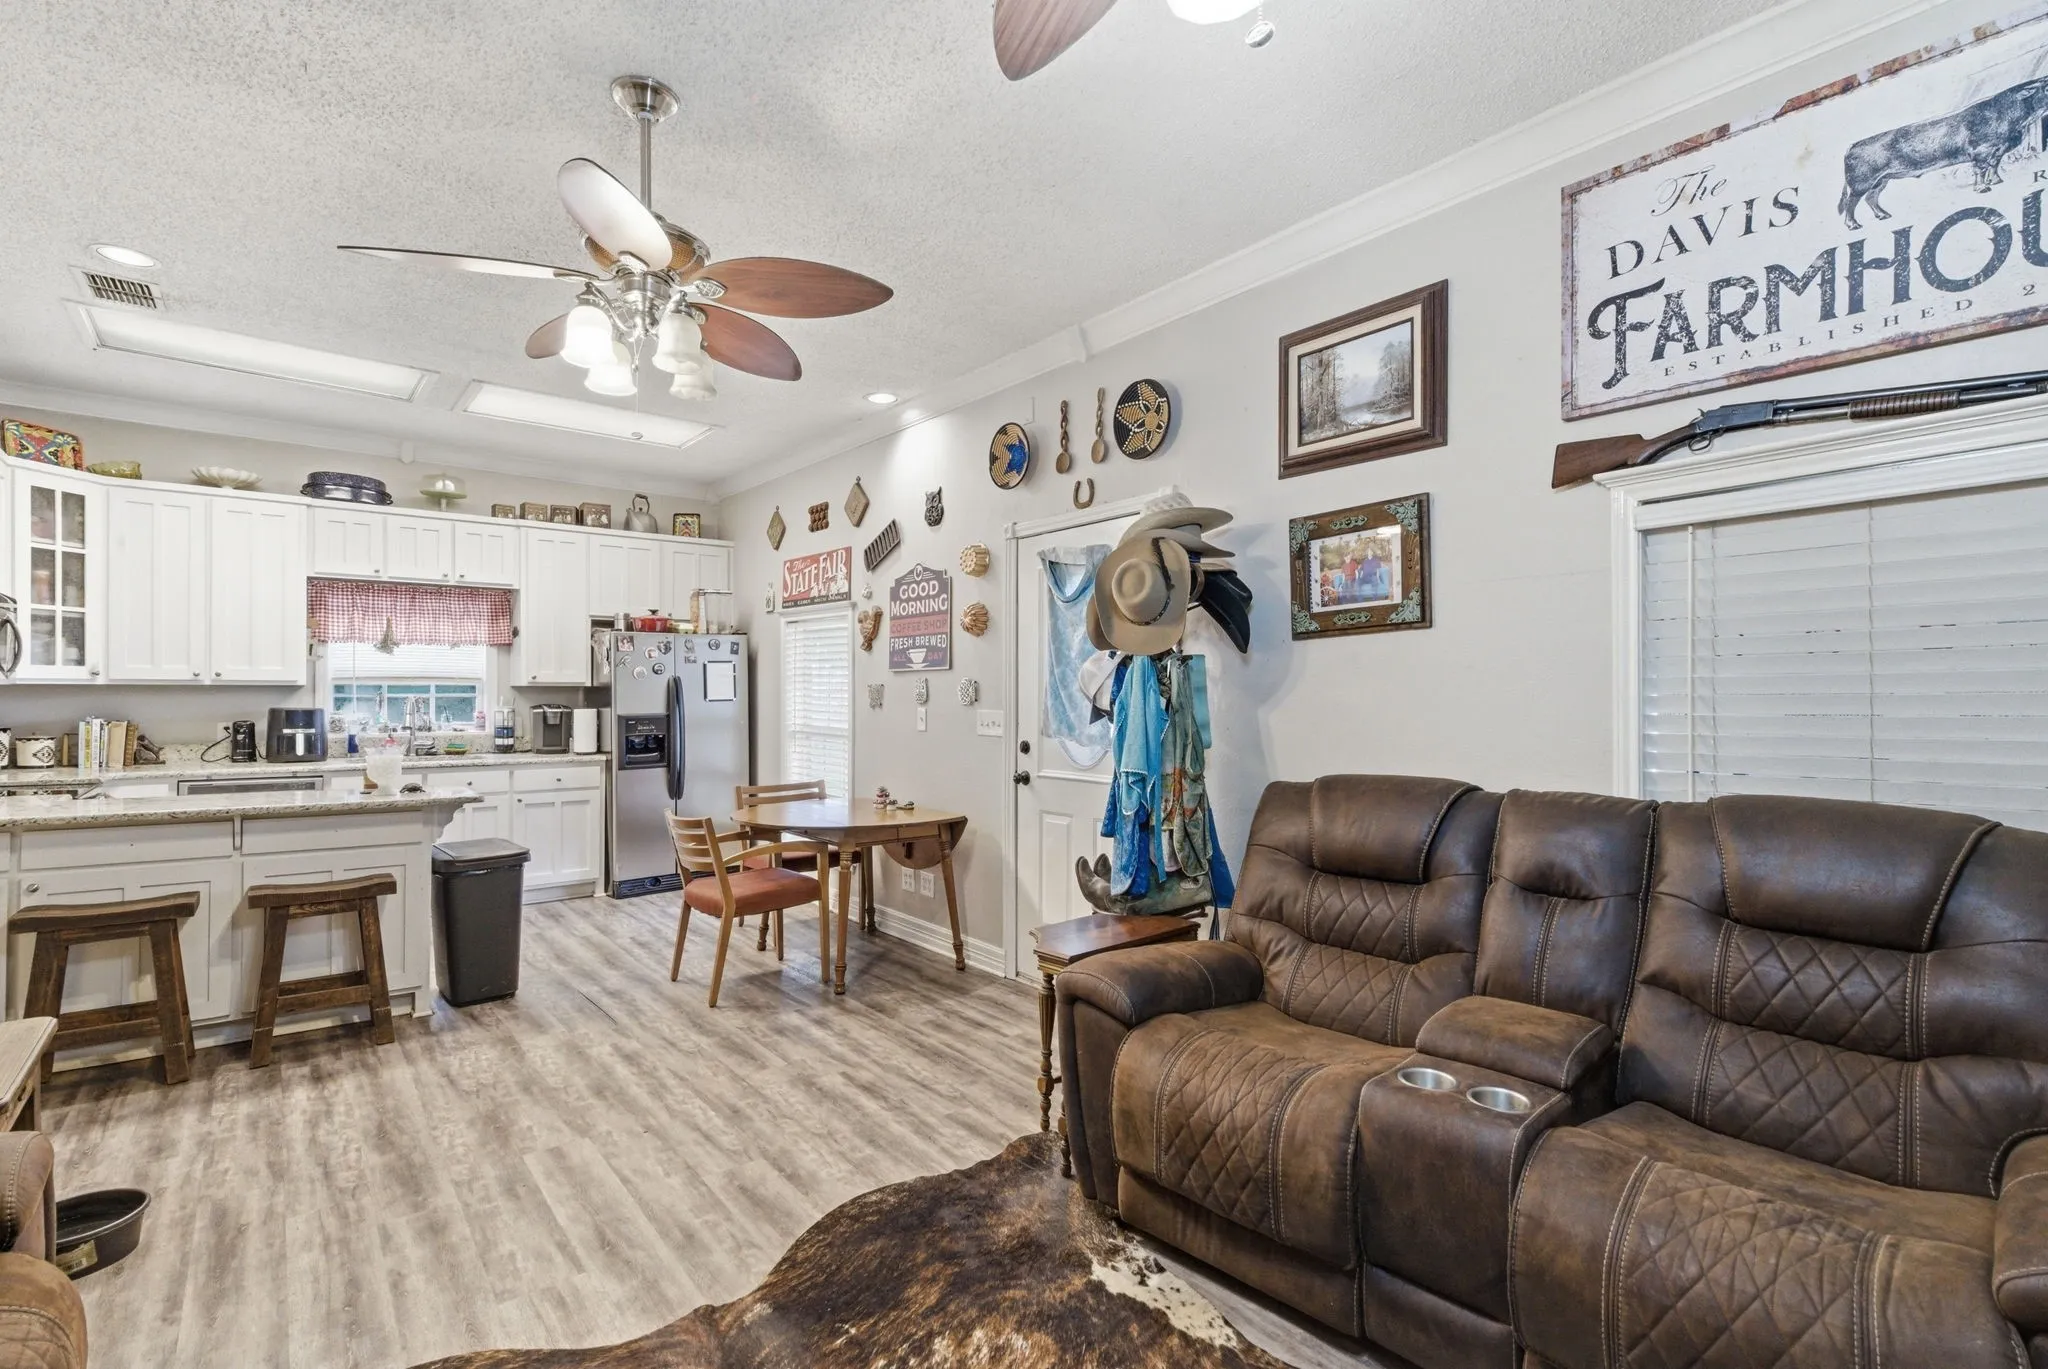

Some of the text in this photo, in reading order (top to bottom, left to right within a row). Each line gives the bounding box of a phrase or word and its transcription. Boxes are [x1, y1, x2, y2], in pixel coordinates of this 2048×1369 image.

[1651, 164, 1727, 216] The
[1604, 186, 1800, 280] DAVIS
[1664, 298, 1973, 377] ESTABLISHED
[783, 549, 848, 598] STATE FAIR
[899, 580, 939, 600] GOOD
[891, 593, 948, 617] MORNING
[890, 634, 947, 652] FRESH BREWED
[891, 618, 947, 634] COFFEE SHOP
